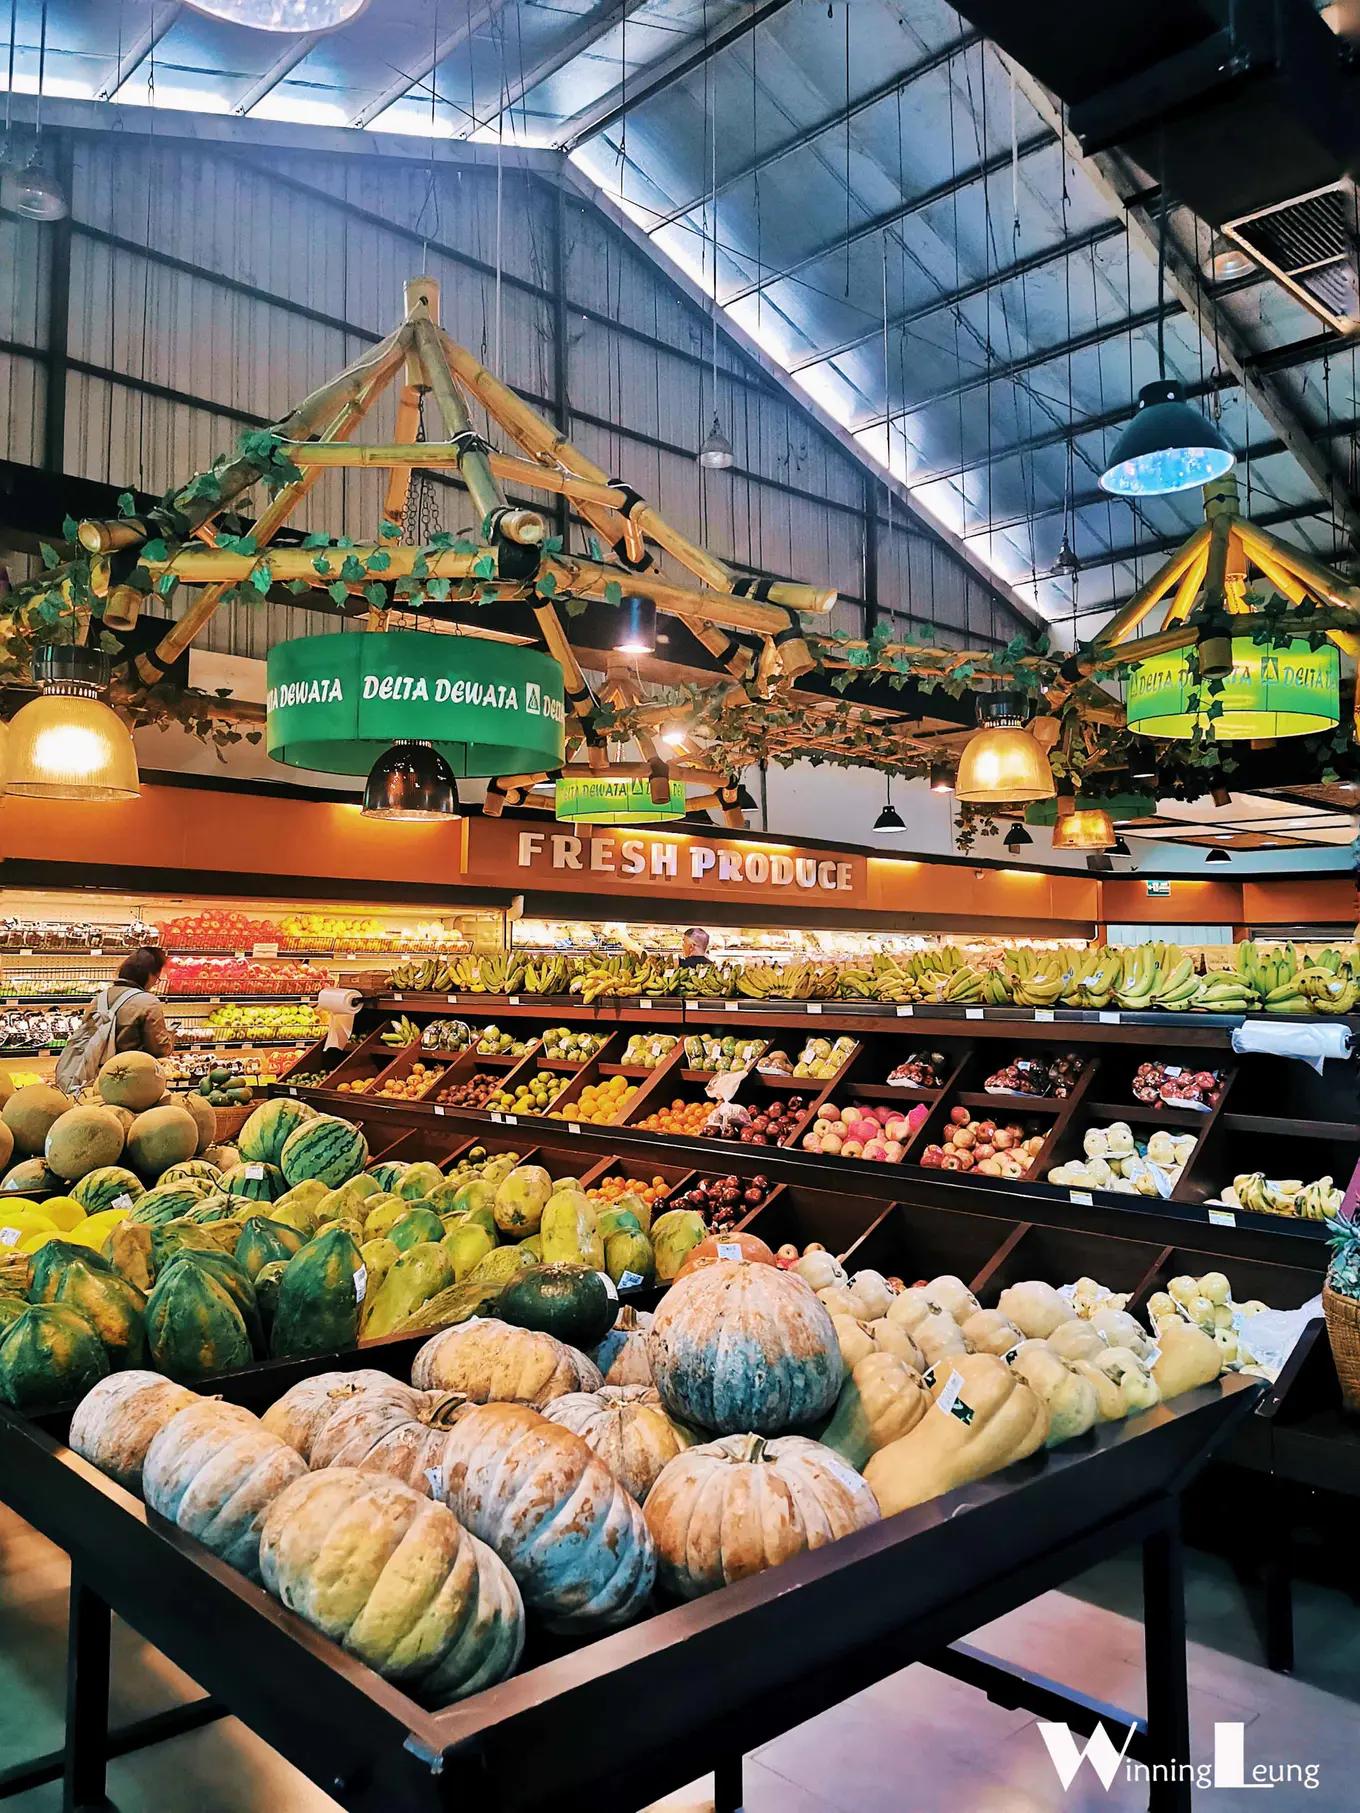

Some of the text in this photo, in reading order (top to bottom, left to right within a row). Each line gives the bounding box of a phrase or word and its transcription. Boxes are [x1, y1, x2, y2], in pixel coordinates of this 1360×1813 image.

[1282, 666, 1324, 689] DELTA
[280, 678, 343, 708] DEWATA
[363, 675, 429, 701] DELTA
[435, 678, 519, 711] DEWATA
[582, 782, 628, 798] DEWATA
[518, 831, 854, 891] FRESH PRODUCE
